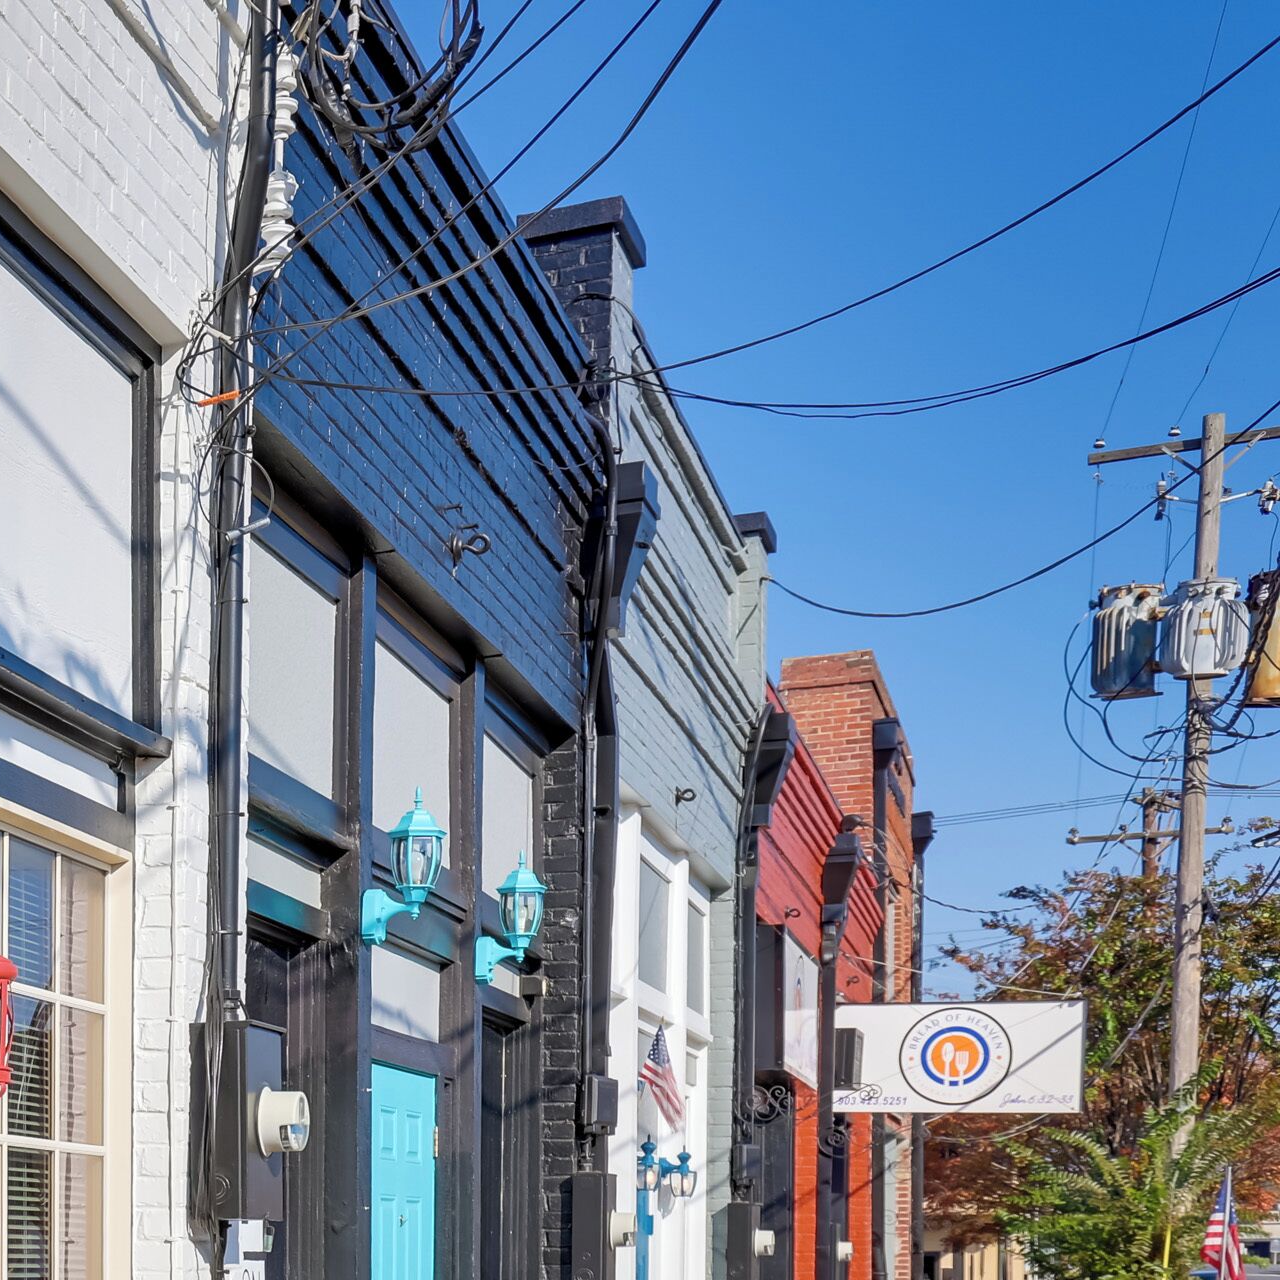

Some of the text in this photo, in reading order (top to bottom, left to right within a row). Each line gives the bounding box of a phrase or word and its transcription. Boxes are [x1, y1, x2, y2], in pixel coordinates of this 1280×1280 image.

[909, 1013, 1004, 1050] BREAD OF HEAVEN
